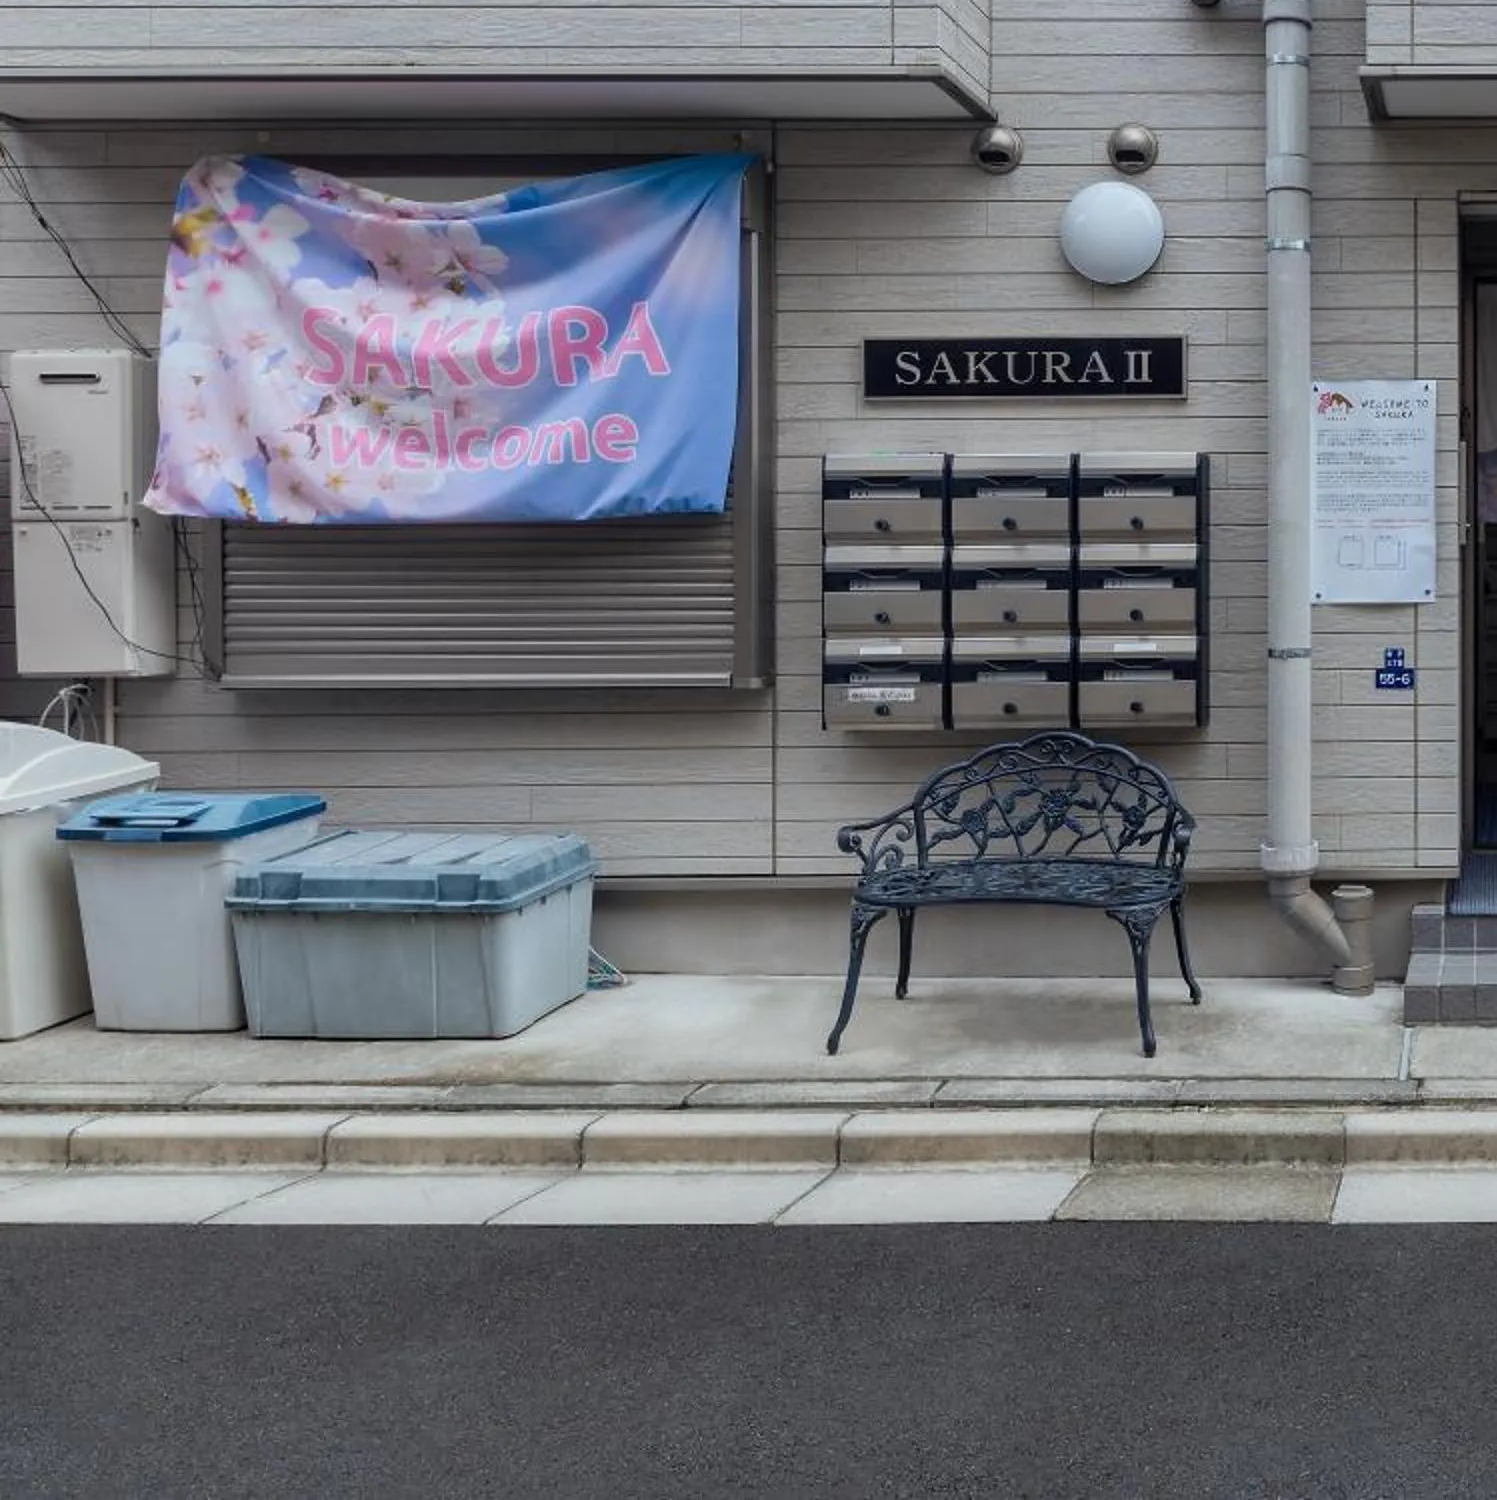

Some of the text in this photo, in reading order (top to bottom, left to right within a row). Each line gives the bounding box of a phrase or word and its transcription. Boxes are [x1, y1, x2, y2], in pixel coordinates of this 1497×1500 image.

[301, 300, 670, 389] SAKURA
[895, 350, 1115, 385] SAKURA
[324, 410, 640, 474] welcome
